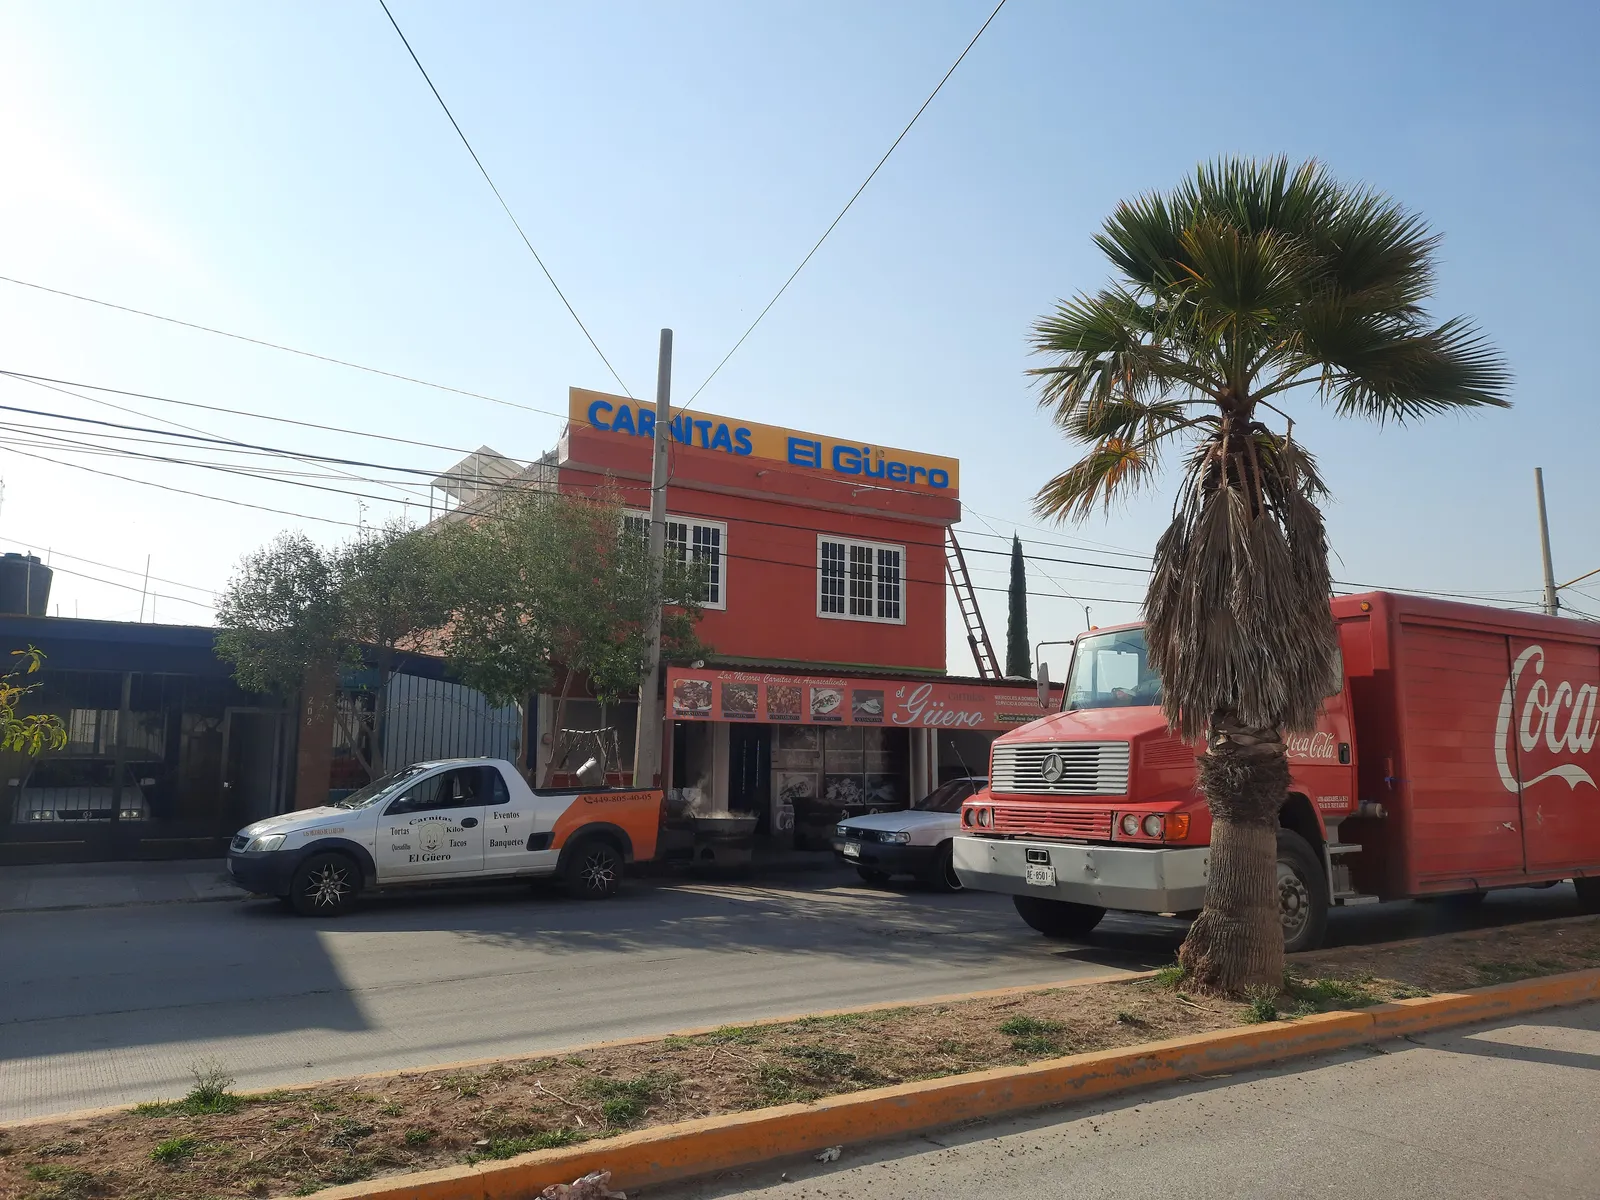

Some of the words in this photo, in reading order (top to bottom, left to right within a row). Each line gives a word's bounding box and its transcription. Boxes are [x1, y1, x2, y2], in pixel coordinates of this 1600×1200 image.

[587, 400, 753, 456] CARNITAS
[787, 436, 823, 469] El
[832, 446, 949, 489] Güero
[717, 671, 732, 680] Las
[733, 672, 761, 683] Mejores
[763, 673, 791, 684] Carnitas
[793, 676, 802, 684] de
[802, 676, 848, 686] Aguascalientes
[896, 686, 906, 698] el
[892, 683, 985, 727] Güero
[1494, 644, 1600, 794] Coca
[1310, 731, 1336, 758] Cola
[408, 814, 452, 826] Carnitas
[493, 811, 520, 820] Eventos
[390, 827, 410, 836] Tortas
[503, 825, 509, 833] Y
[449, 839, 467, 848] Tacos
[489, 837, 524, 849] Banquetes
[408, 854, 420, 862] El
[422, 852, 451, 862] Güero
